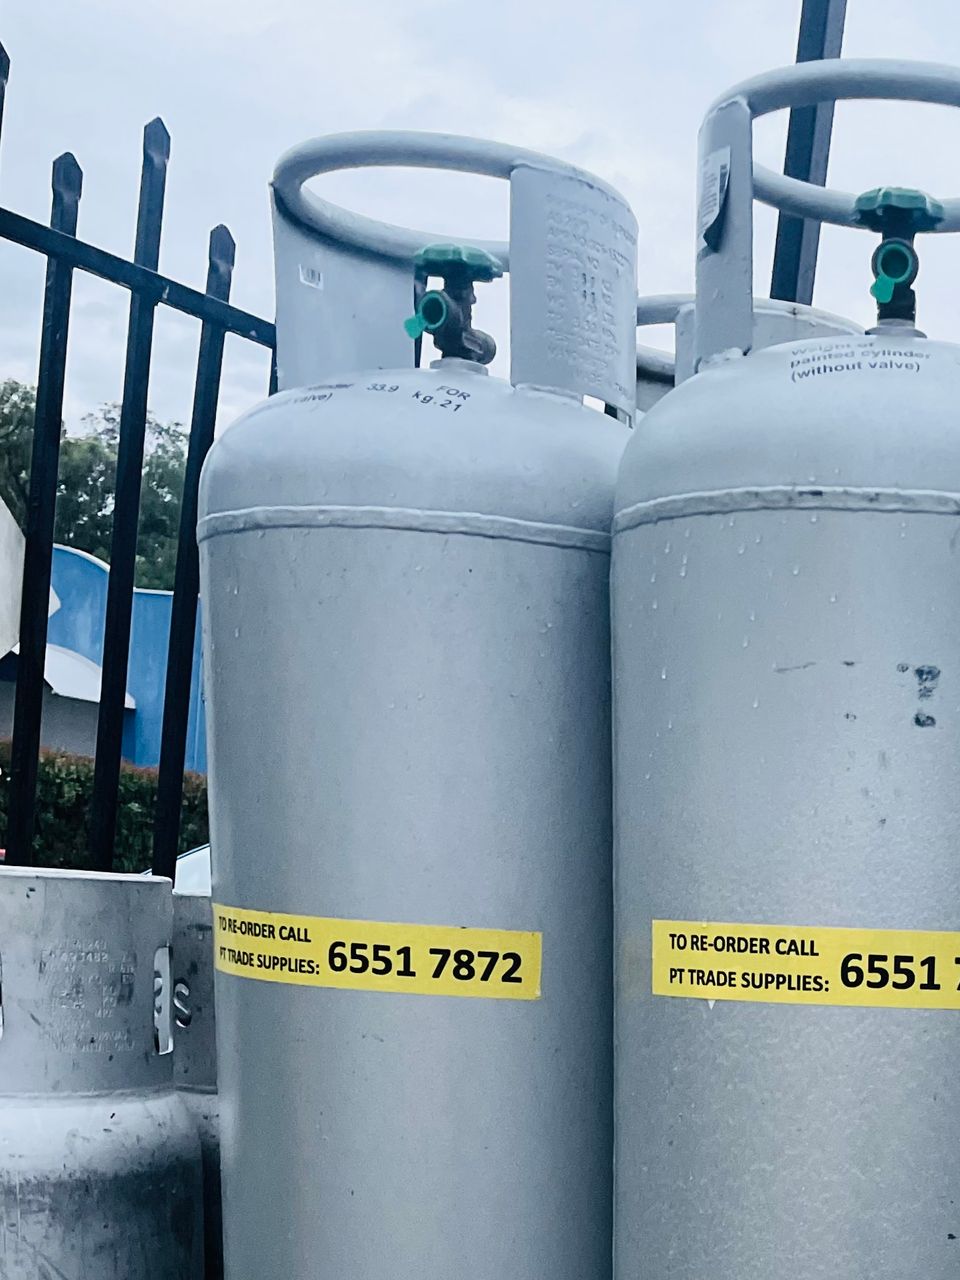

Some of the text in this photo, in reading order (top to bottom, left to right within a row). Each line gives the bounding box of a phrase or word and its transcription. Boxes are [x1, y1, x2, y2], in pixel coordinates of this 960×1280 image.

[790, 348, 932, 369] painted cylinder
[791, 359, 920, 383] (without valve)
[436, 385, 471, 401] FOR
[218, 915, 312, 943] TO RE-ORDER CALL
[669, 933, 820, 957] TO RE-ORDER CALL
[219, 940, 522, 984] PT TRADE SUPPLIES: 6551 7872
[669, 967, 685, 985] PT
[687, 968, 737, 988] TRADE
[740, 971, 830, 993] SUPPLIES:
[840, 953, 941, 991] 6551
